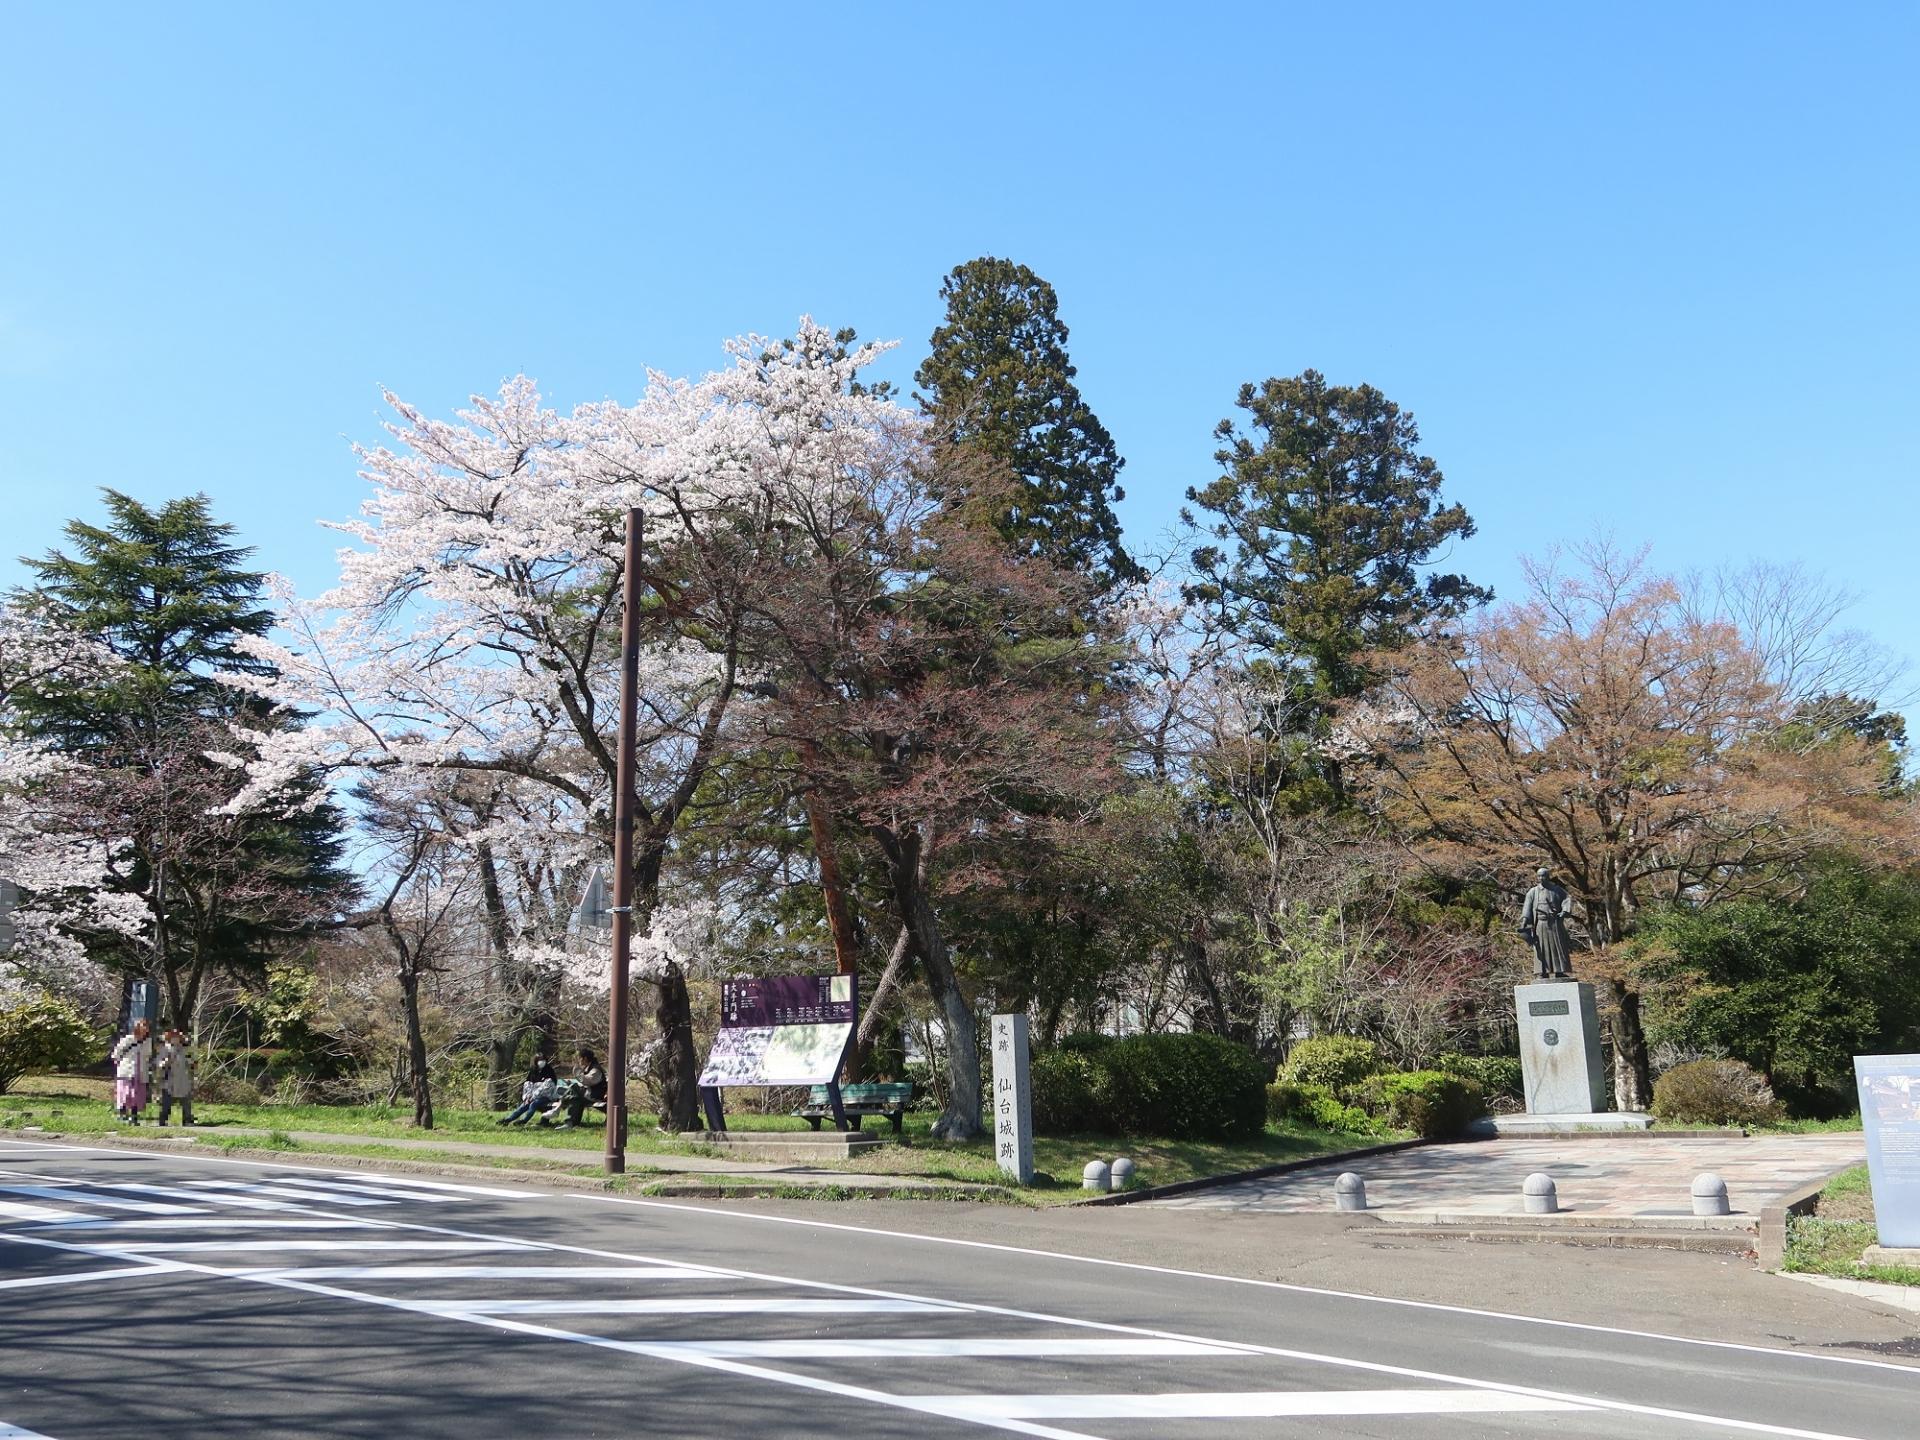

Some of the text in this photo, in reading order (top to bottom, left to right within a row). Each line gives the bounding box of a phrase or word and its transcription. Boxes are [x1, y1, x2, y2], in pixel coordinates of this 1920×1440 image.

[998, 1023, 1015, 1159] 史跡 仙台城跡
